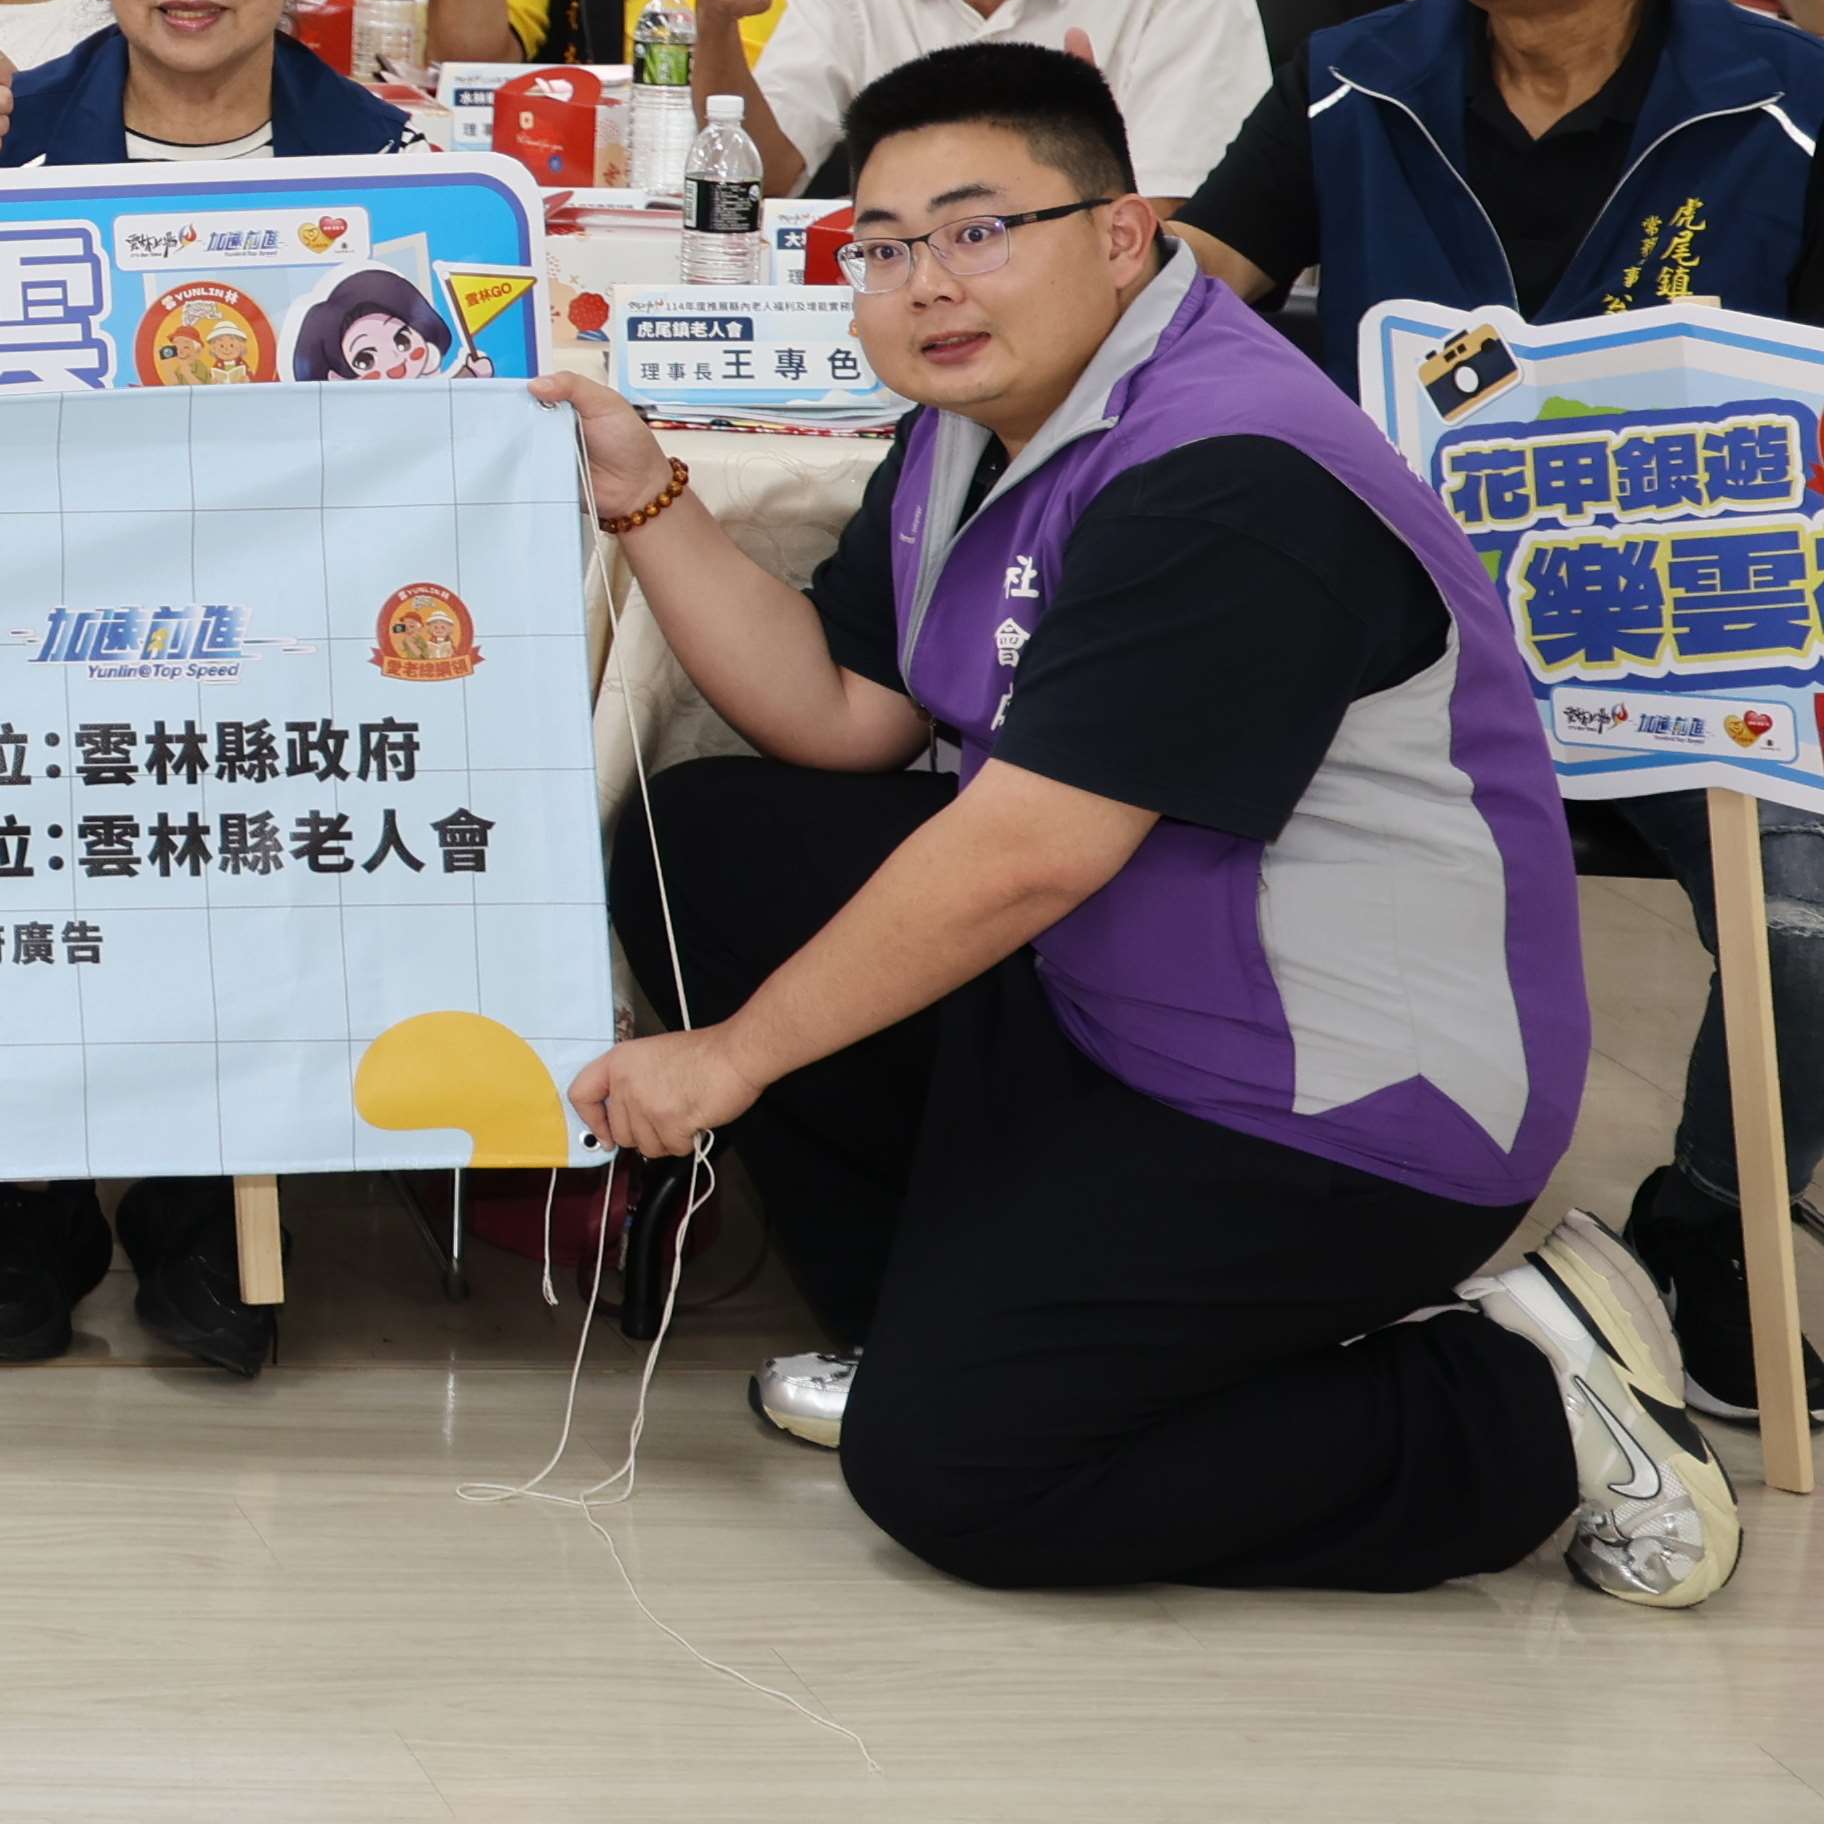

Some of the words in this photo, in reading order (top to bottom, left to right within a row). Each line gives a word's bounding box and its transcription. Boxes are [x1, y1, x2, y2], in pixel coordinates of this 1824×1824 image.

[1656, 197, 1707, 297] 虎尾鎮
[465, 282, 512, 307] 雲林GO
[637, 320, 743, 339] 虎尾鎮老人會
[641, 362, 712, 381] 理事長
[722, 348, 861, 381] 王專色
[1450, 425, 1791, 523] 花甲銀遊
[1524, 529, 1824, 667] 樂雲
[32, 605, 252, 663] 加速前進
[87, 664, 181, 680] Yunlin@Top
[186, 662, 239, 680] Speed
